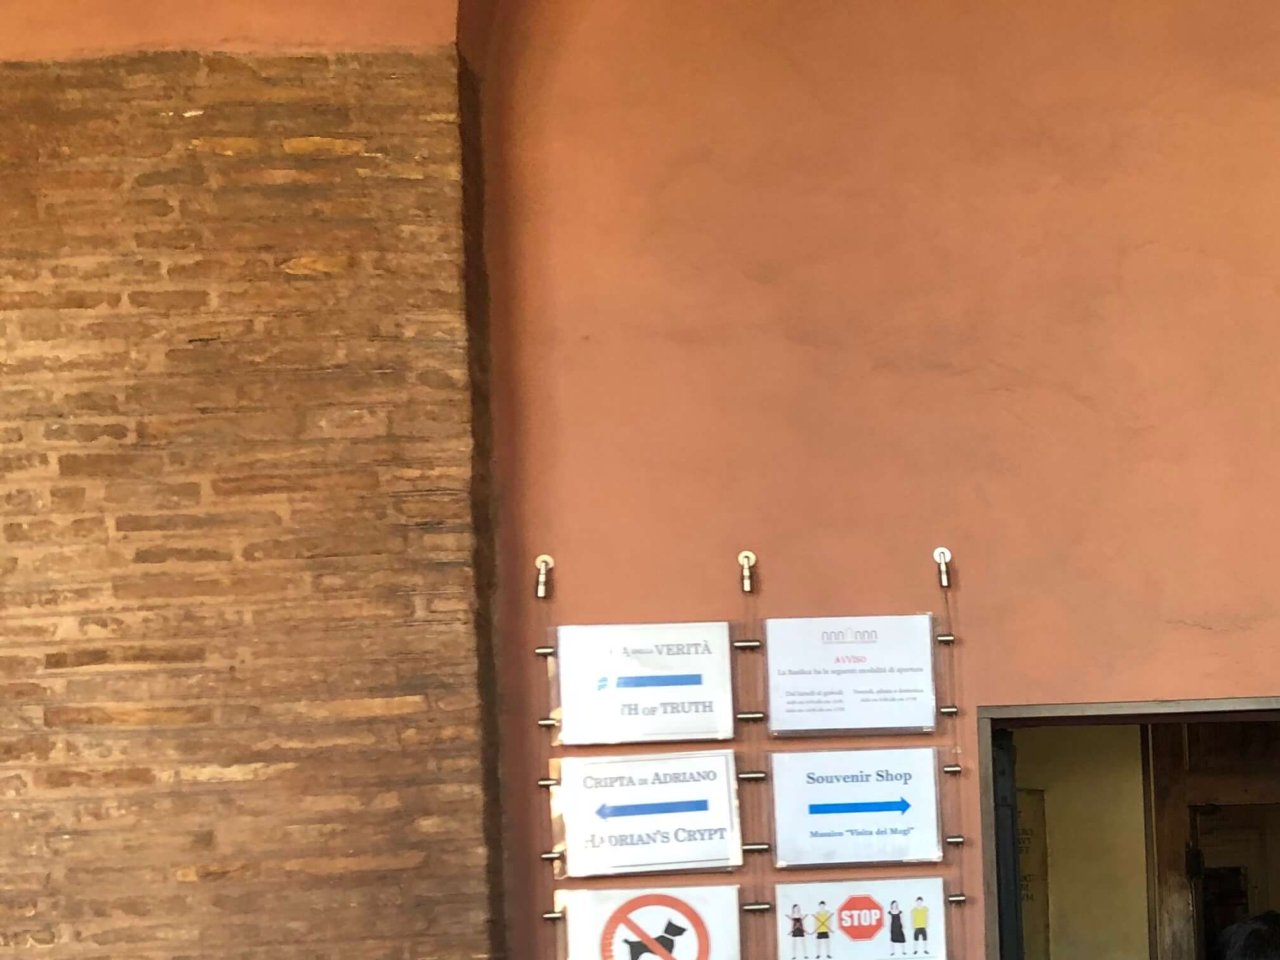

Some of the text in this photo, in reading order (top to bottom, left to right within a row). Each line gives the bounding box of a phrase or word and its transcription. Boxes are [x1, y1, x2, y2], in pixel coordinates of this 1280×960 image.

[654, 640, 712, 655] VERITÀ
[660, 701, 714, 715] TRUTH
[583, 776, 635, 789] CRIPTA
[651, 770, 717, 784] ADRIANO
[806, 769, 912, 785] Souvenir Shop
[674, 828, 727, 842] CRYPT
[841, 909, 880, 926] STOP
